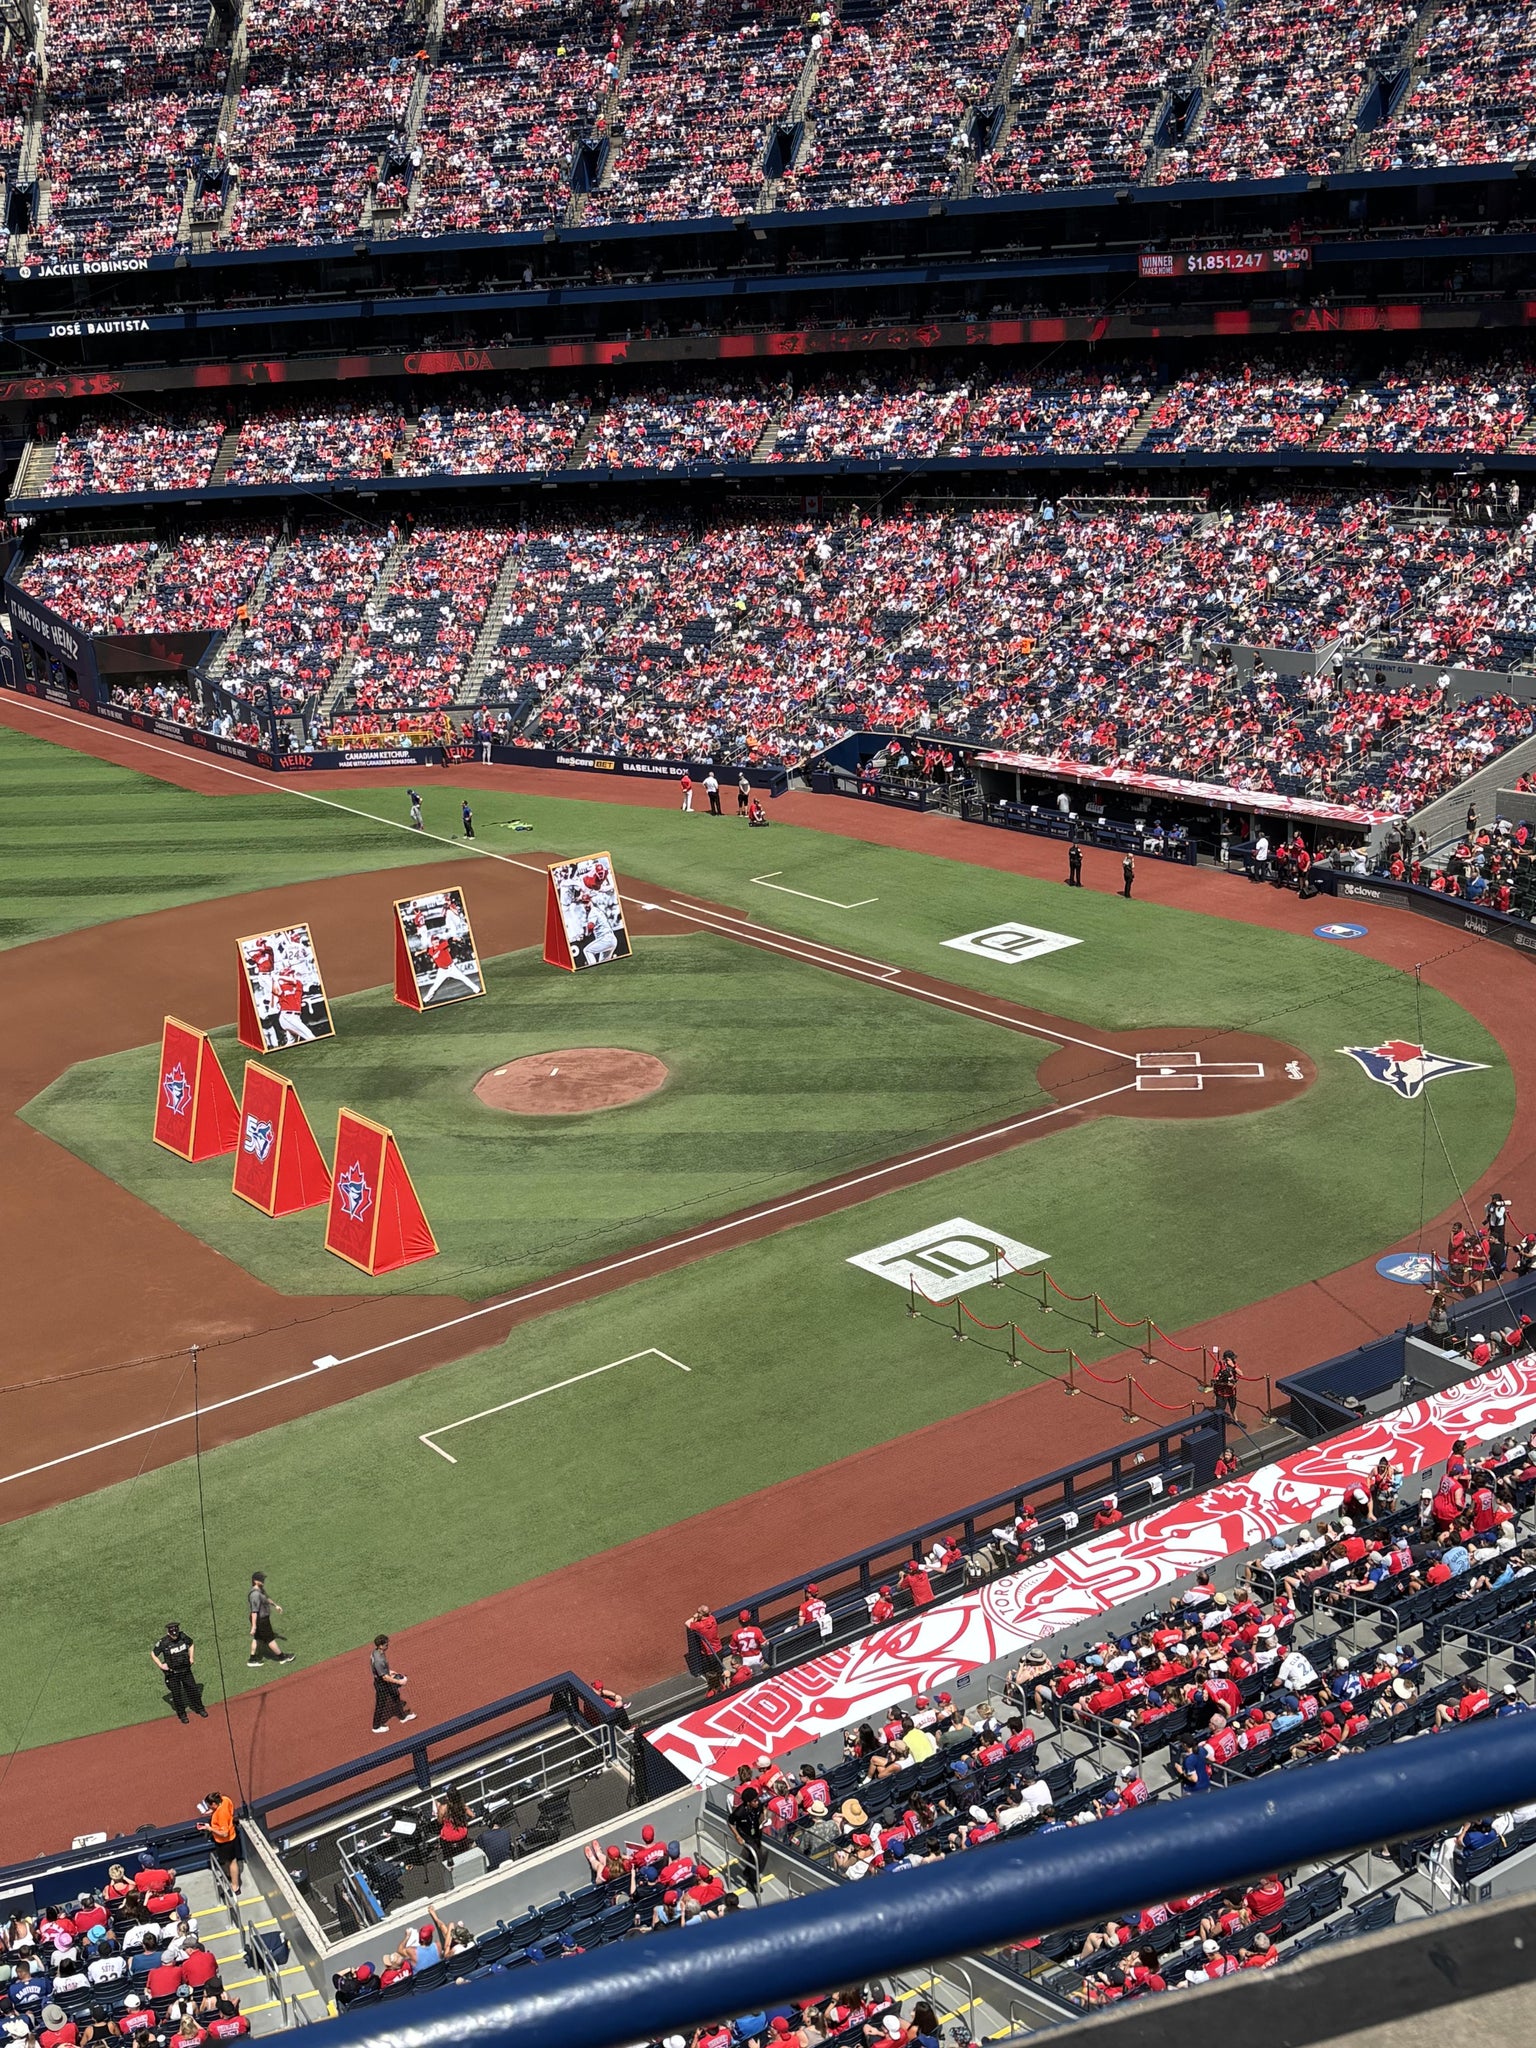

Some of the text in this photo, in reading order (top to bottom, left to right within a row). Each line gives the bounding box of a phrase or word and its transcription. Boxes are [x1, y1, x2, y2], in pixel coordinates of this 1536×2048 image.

[38, 263, 81, 277] JACKIE
[83, 259, 148, 273] ROBINSON
[1141, 256, 1173, 267] WINNER
[1142, 266, 1173, 275] TAKES HOME
[49, 320, 150, 337] JOSÉ BAUTISTA
[10, 600, 18, 617] IT
[17, 605, 31, 626] HAS
[31, 614, 41, 633] TO
[41, 621, 51, 639] BE
[51, 626, 79, 660] HEINZ
[1397, 666, 1413, 674] CLUB
[279, 755, 314, 768] HEINZ
[345, 752, 378, 761] CANADIAN
[556, 755, 594, 767] theScore
[623, 763, 689, 776] BASELINE BOX
[1353, 885, 1381, 899] clover
[1463, 919, 1488, 934] KPMG
[877, 1234, 1007, 1280] TD
[738, 1638, 757, 1652] 24
